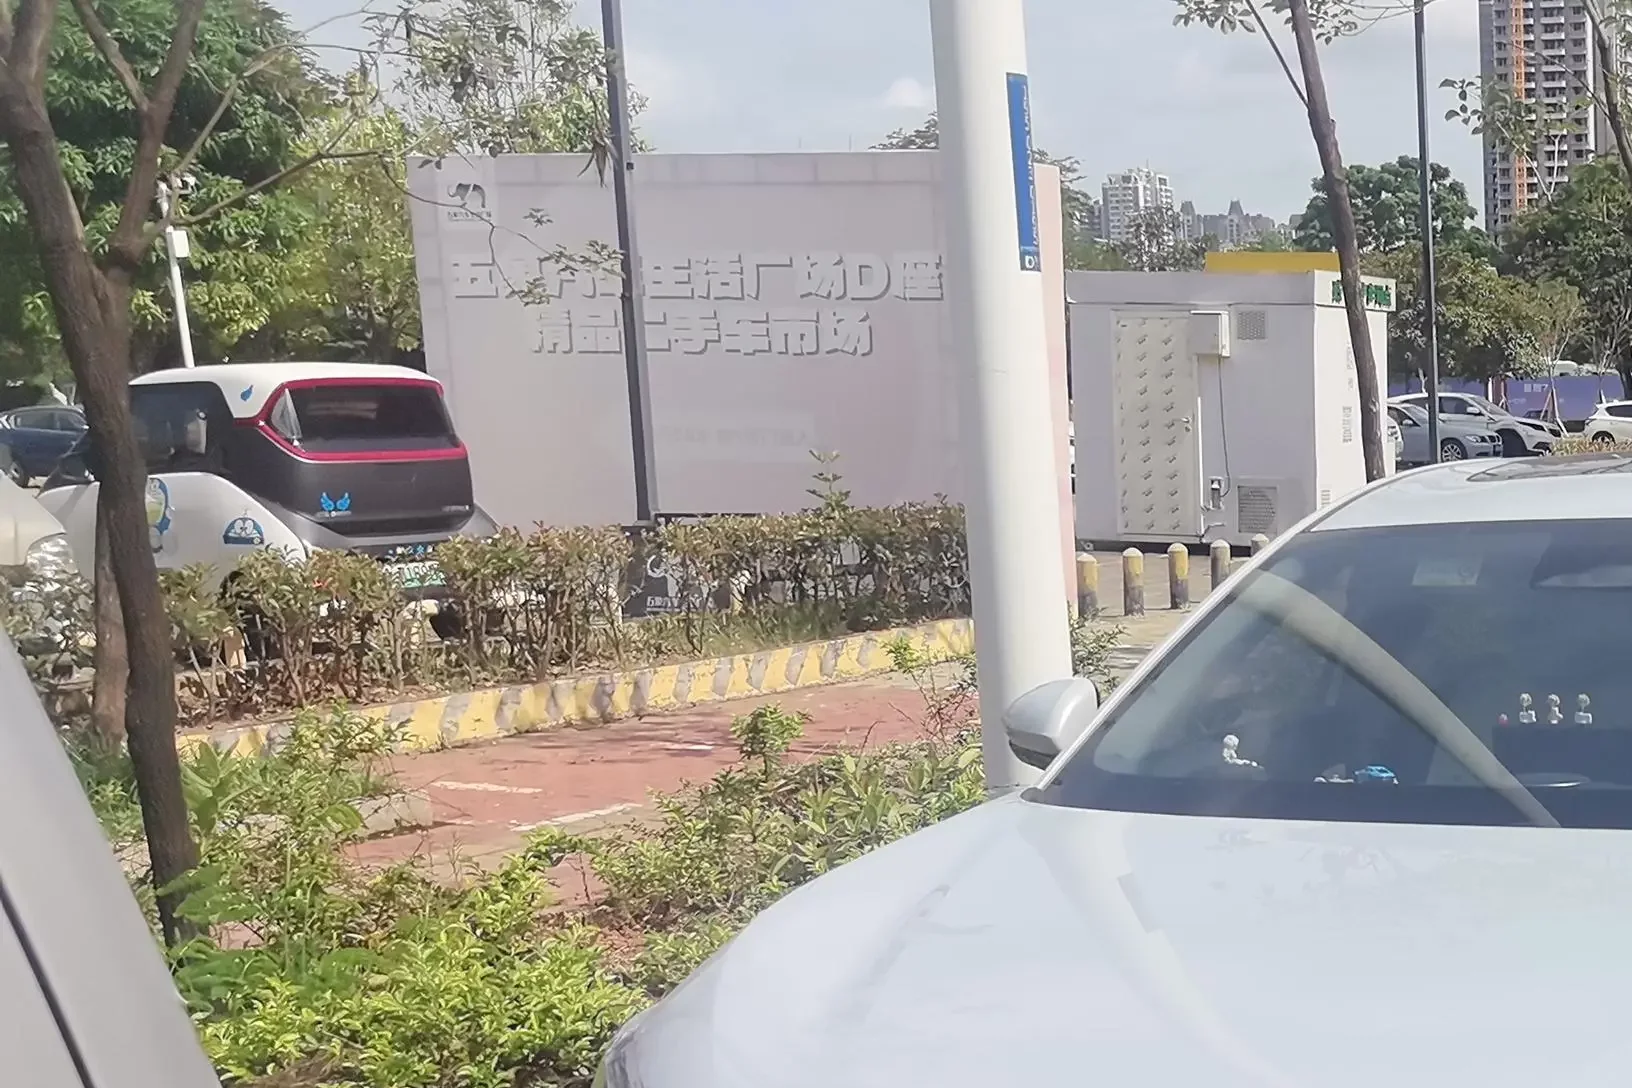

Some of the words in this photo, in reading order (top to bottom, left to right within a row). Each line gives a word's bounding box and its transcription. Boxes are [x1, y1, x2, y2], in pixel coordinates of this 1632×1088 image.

[449, 252, 944, 300] 五生活广场D座
